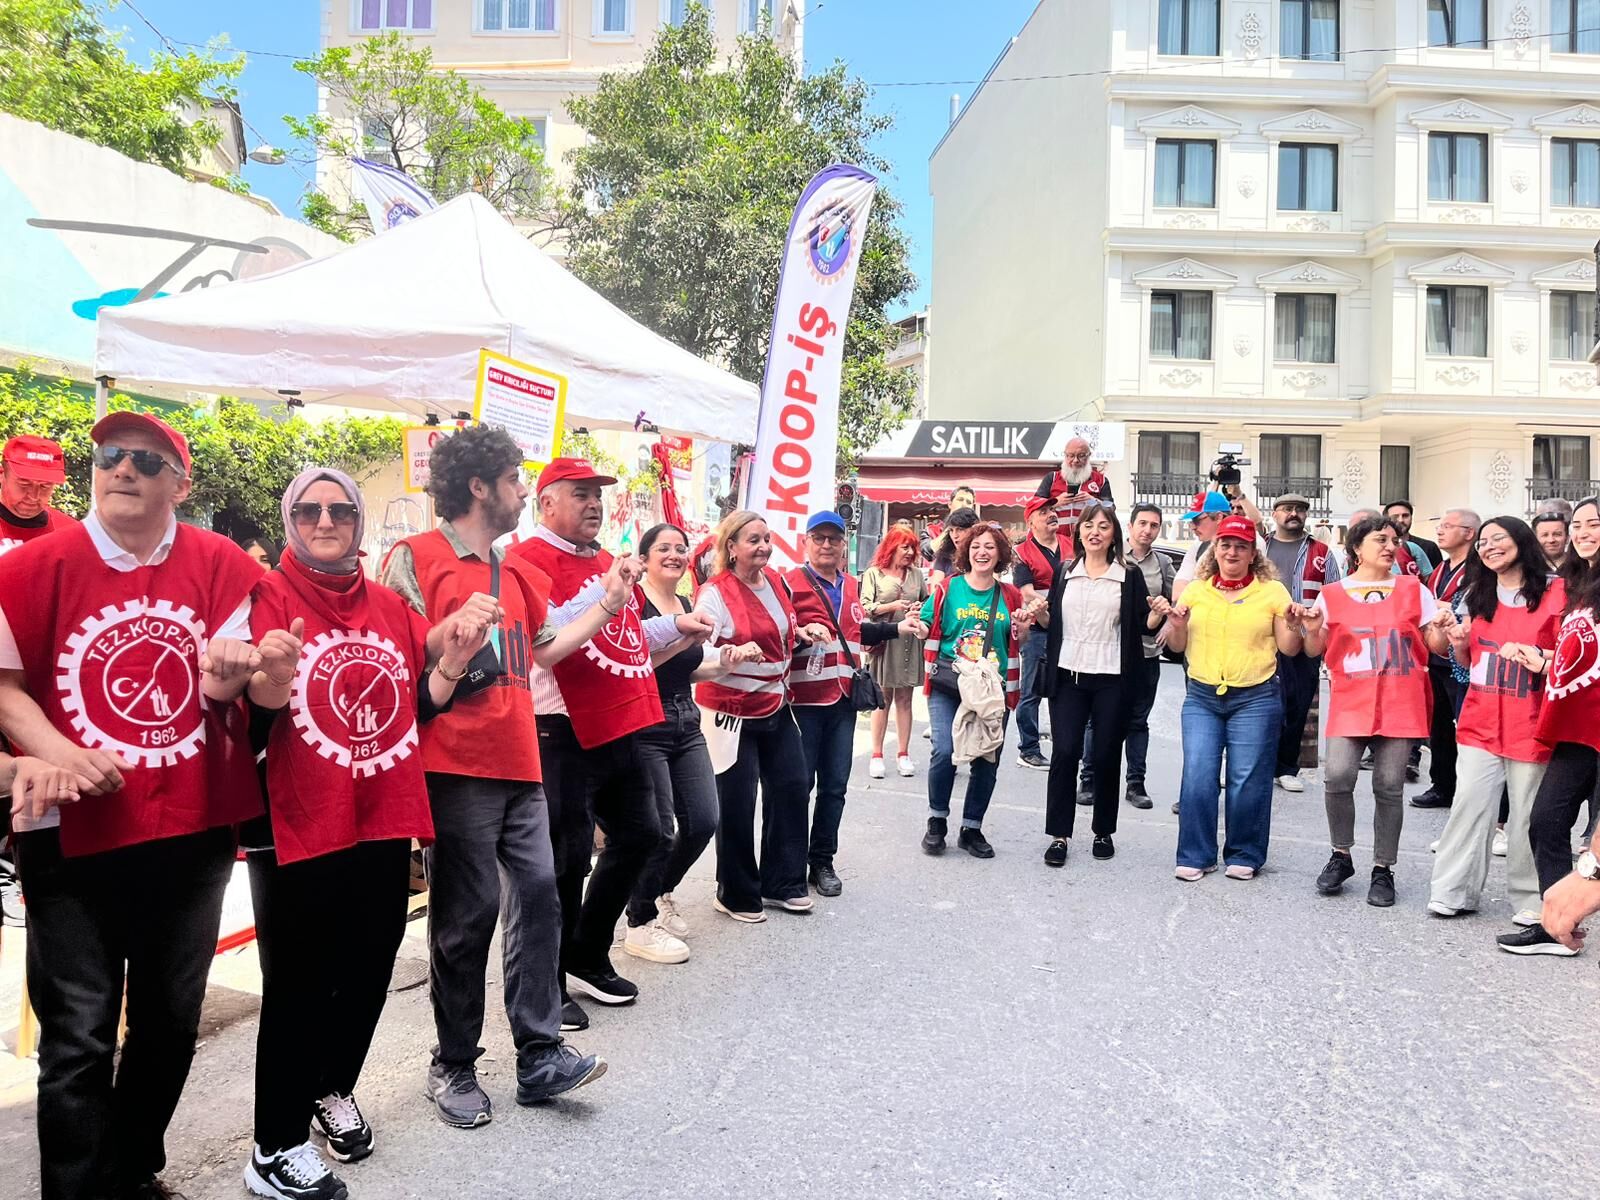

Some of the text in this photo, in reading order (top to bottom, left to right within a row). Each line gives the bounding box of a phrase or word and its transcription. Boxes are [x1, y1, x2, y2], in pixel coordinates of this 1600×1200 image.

[766, 302, 837, 574] Z-KOOP-İŞ
[931, 425, 1030, 455] SATILIK
[139, 726, 178, 745] 1962
